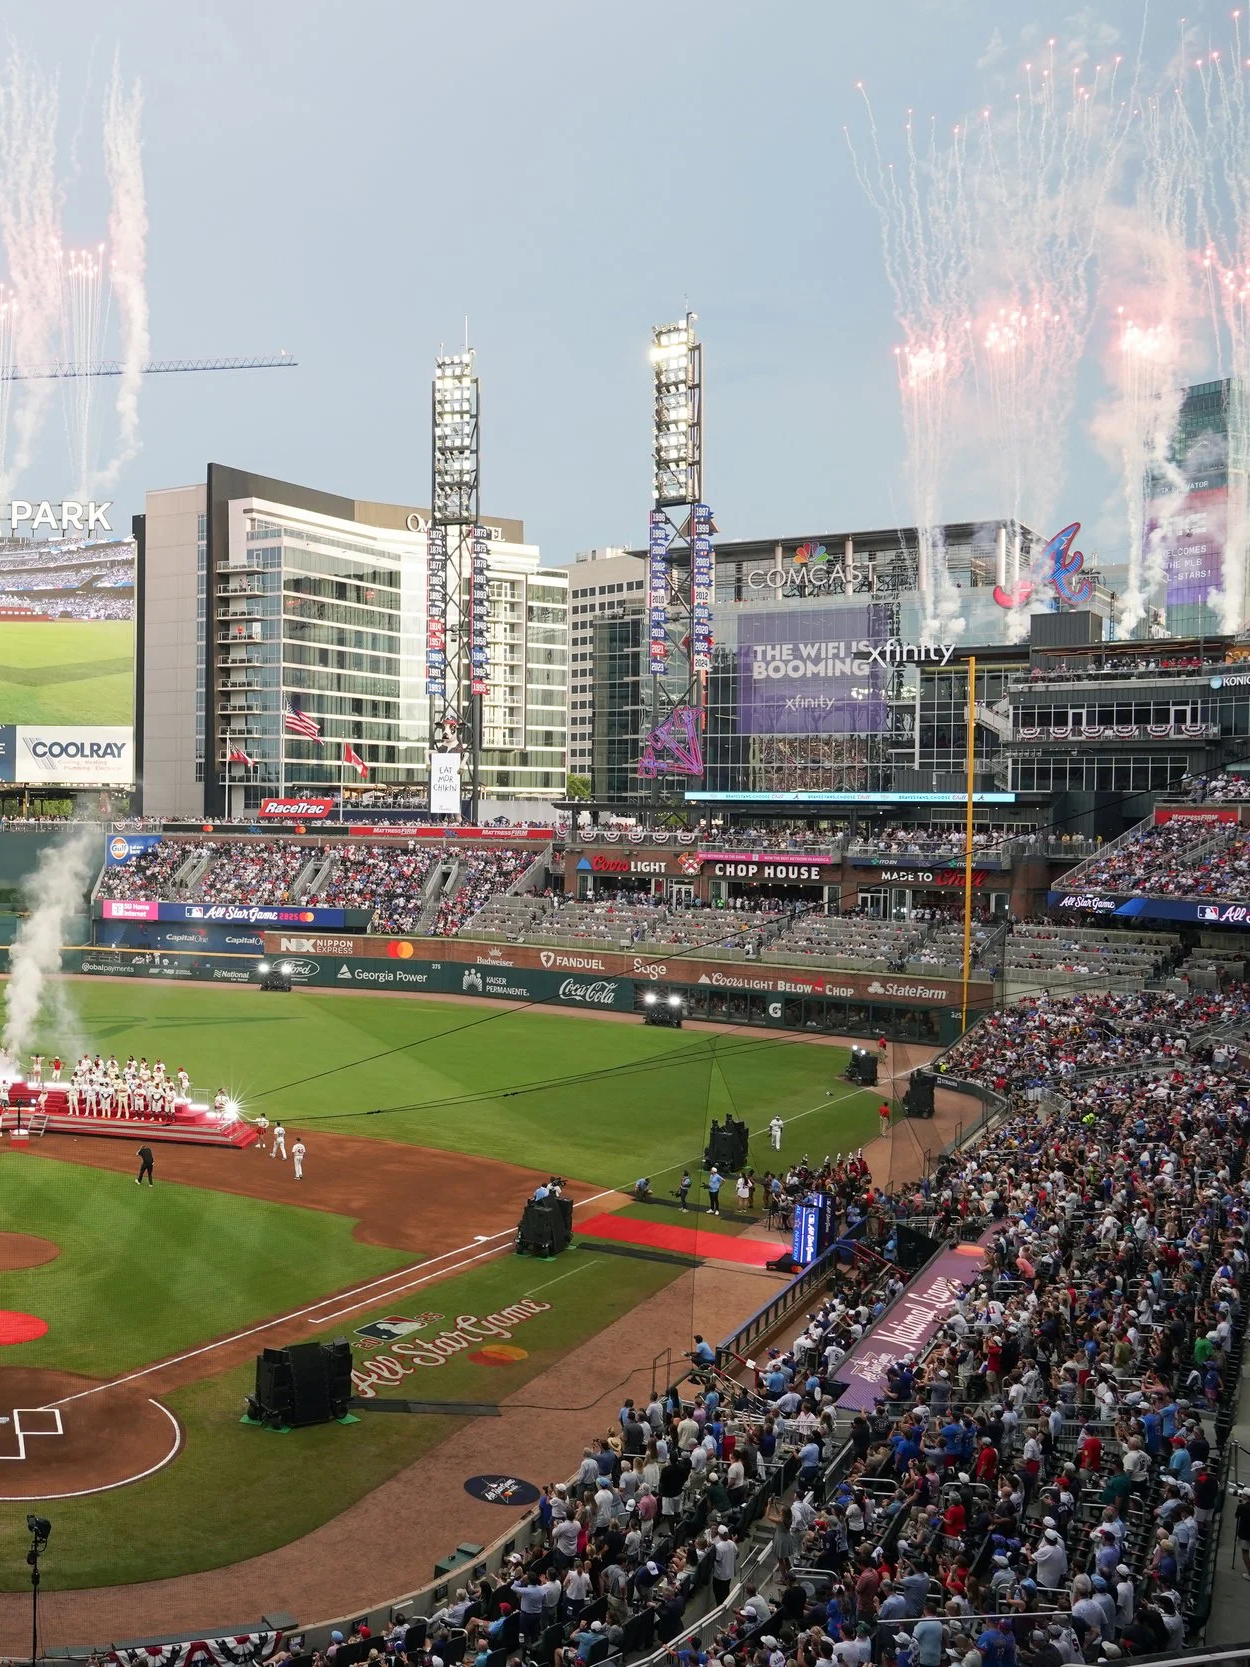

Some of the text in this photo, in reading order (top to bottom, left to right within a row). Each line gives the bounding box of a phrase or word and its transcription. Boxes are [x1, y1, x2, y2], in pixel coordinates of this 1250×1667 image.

[10, 500, 114, 532] PARK
[748, 561, 877, 590] COMCAST
[752, 643, 794, 662] THE
[799, 640, 849, 660] WIFI
[866, 638, 956, 668] xfinity
[752, 657, 870, 680] BOOMING
[785, 693, 835, 712] xfinity
[32, 741, 127, 758] COOLRAY
[264, 802, 325, 814] RaceTrac
[111, 843, 128, 853] Gulf
[591, 855, 667, 873] Coors LIGHT
[715, 863, 759, 878] CHOP
[764, 864, 821, 880] HOUSE
[881, 871, 915, 881] MADE
[917, 872, 933, 882] TO
[132, 904, 150, 912] Home
[1059, 896, 1116, 910] All Star Game
[203, 905, 226, 919] All
[226, 906, 250, 920] Star
[249, 907, 278, 923] Game
[1220, 905, 1246, 922] All
[316, 939, 354, 948] NIPPON
[316, 946, 354, 954] EXPRESS
[476, 956, 514, 968] Budweiser
[556, 956, 605, 970] FANDUEL
[633, 958, 667, 980] Sage
[221, 969, 250, 979] National
[354, 969, 428, 984] Georgia Power
[486, 976, 507, 986] KAISER
[711, 972, 774, 990] Coors LIGHT
[486, 985, 528, 997] PERMANENTE
[558, 978, 620, 1004] Coca-Cola
[777, 980, 855, 997] BELOW CHOP
[871, 1292, 938, 1351] National
[350, 1298, 553, 1399] All Star Game
